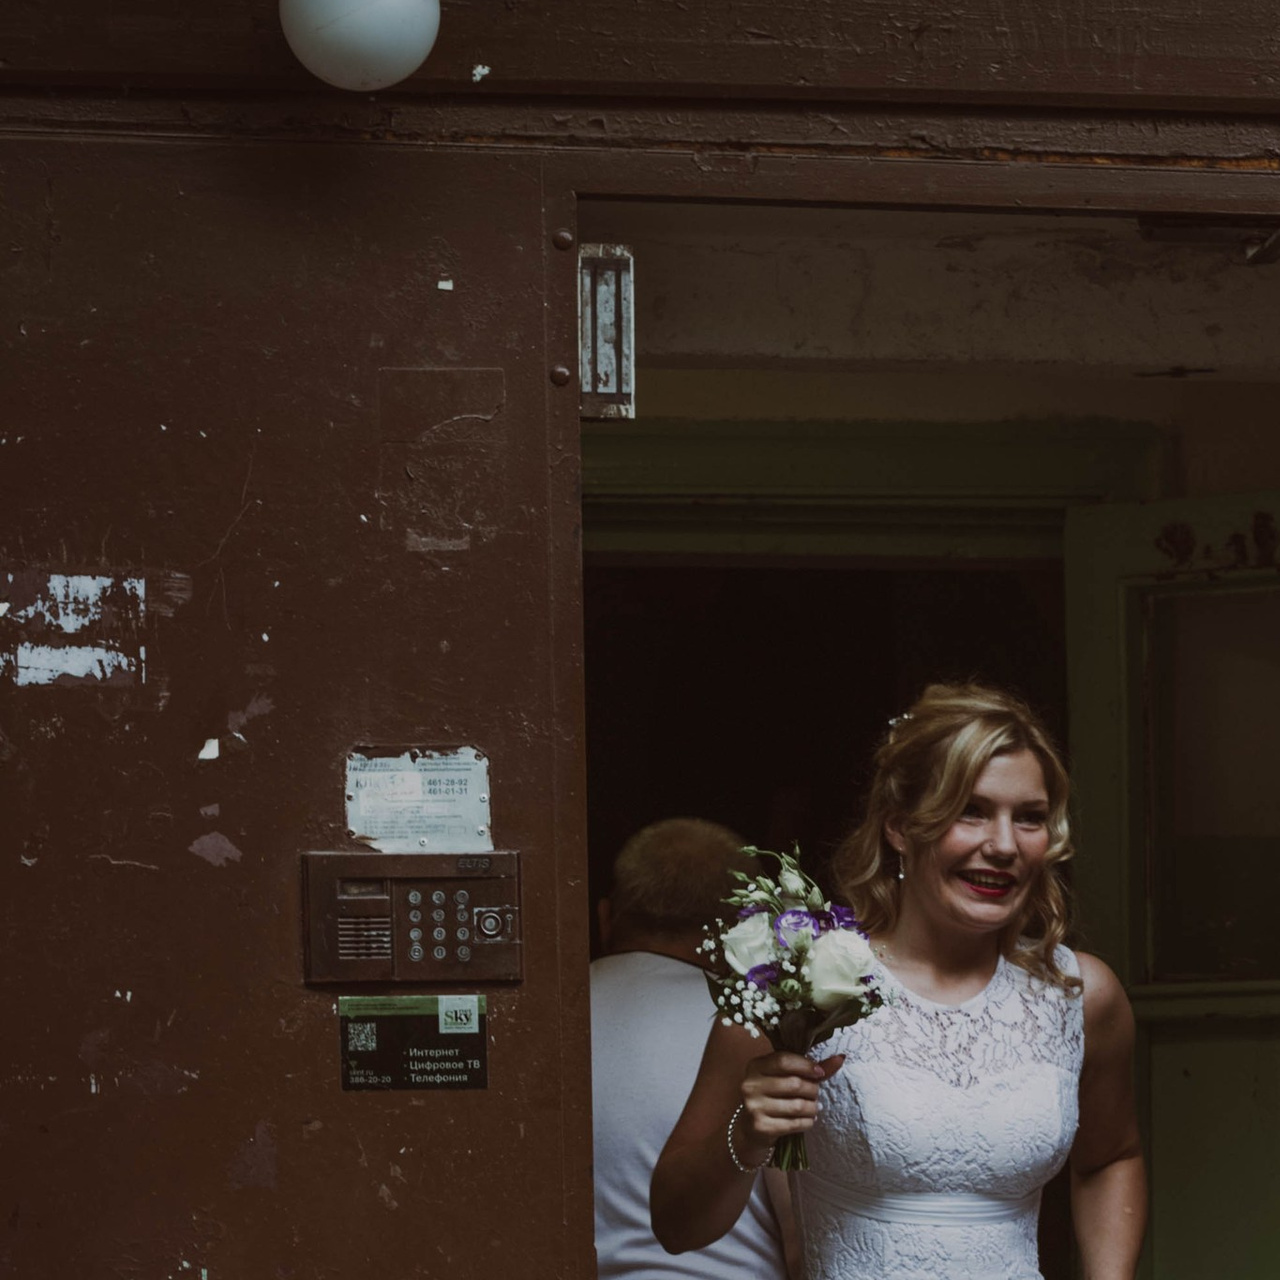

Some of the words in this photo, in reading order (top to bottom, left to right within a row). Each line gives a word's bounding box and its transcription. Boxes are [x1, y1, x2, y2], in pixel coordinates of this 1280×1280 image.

[458, 858, 490, 868] ELTIS
[409, 1048, 459, 1058] Интернет
[409, 1060, 465, 1071] Цифровое
[466, 1060, 481, 1069] ТВ
[409, 1073, 468, 1083] Телефония
